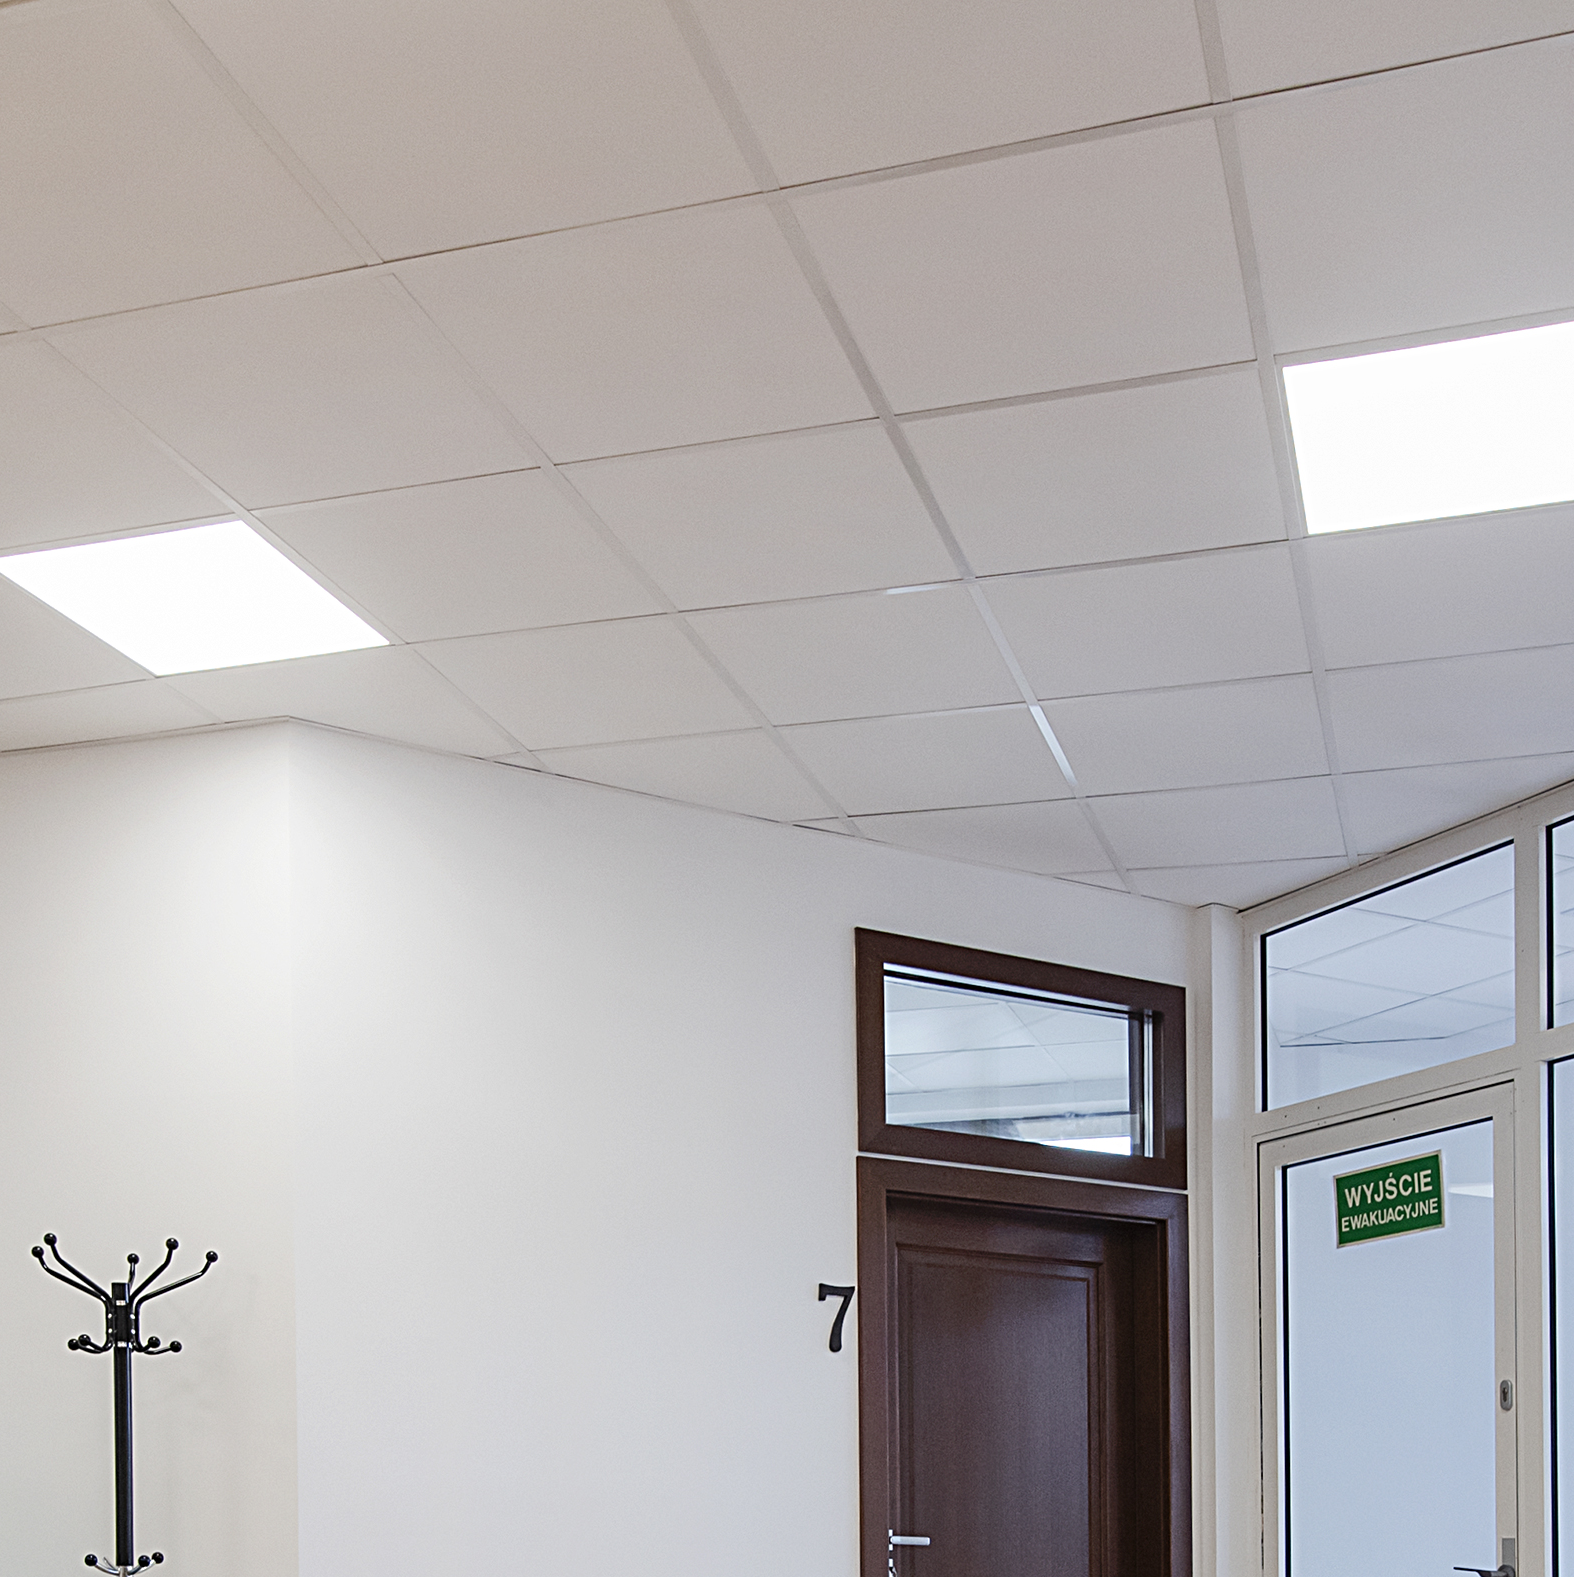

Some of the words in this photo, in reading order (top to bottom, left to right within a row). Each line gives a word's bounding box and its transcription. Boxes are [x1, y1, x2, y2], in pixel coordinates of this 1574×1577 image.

[1345, 1169, 1433, 1208] WYJŚCIE
[1341, 1197, 1439, 1232] EWAKUACYJNE
[818, 1283, 856, 1353] 7
